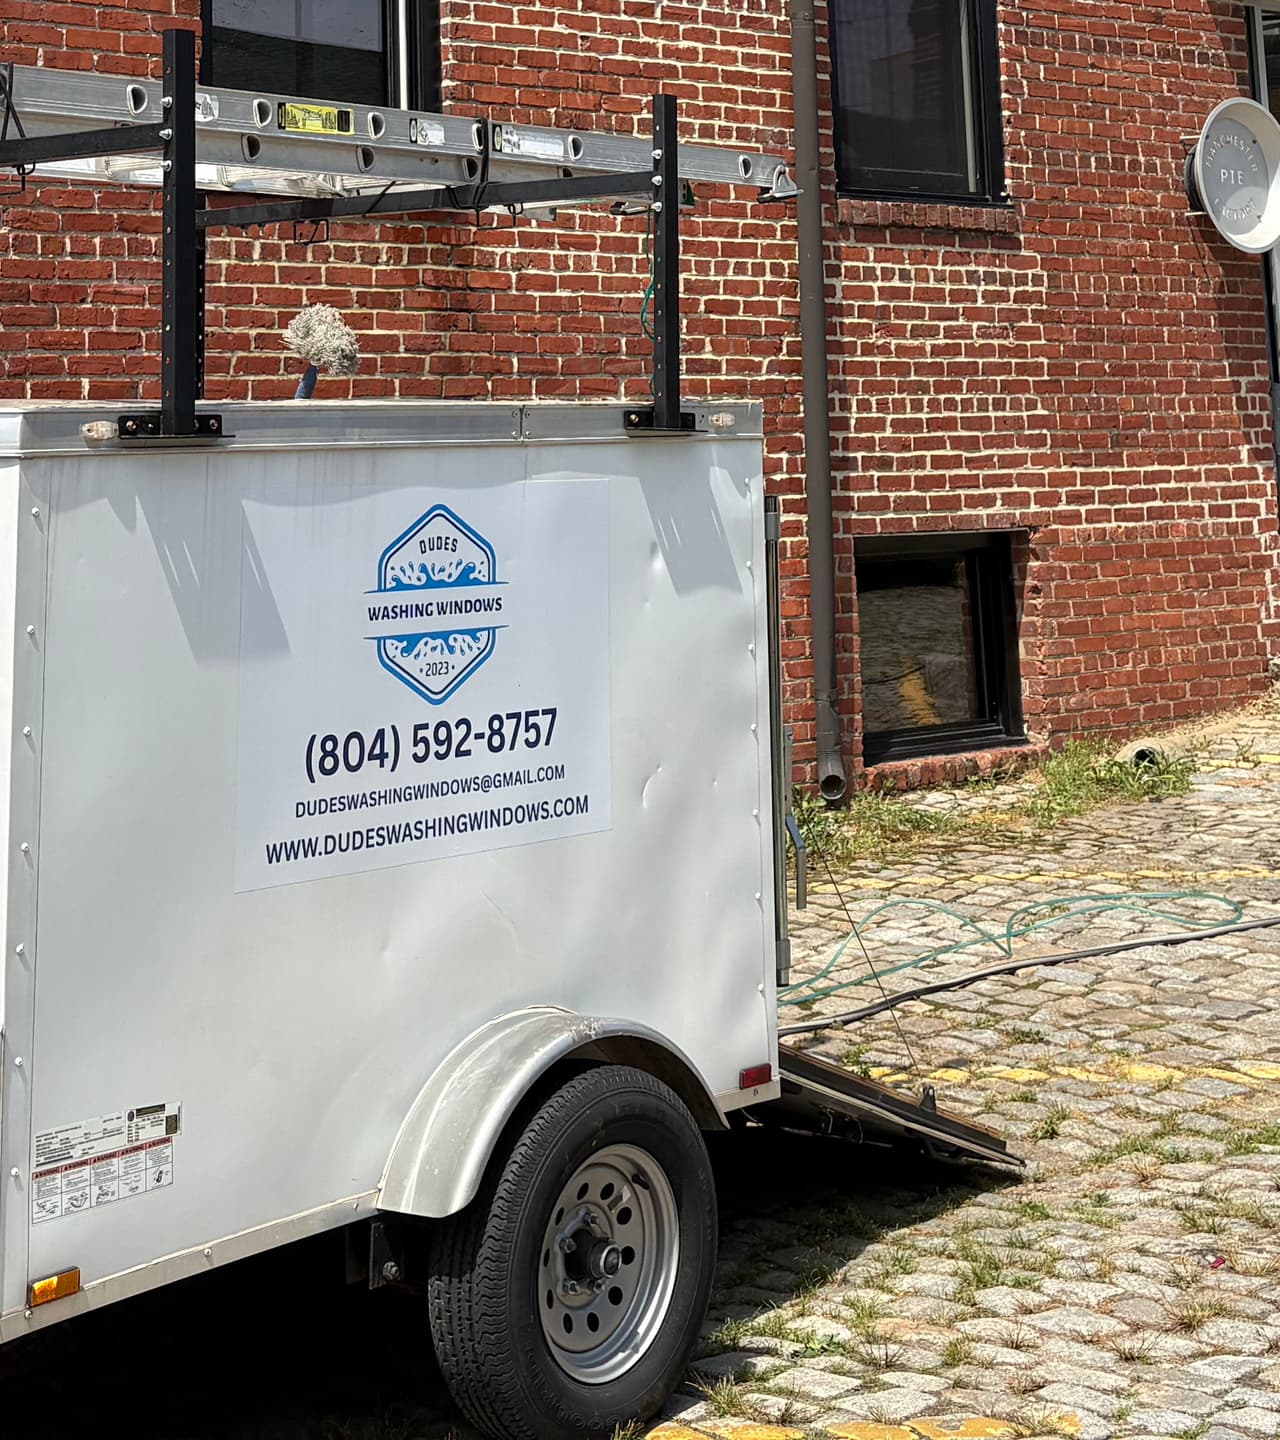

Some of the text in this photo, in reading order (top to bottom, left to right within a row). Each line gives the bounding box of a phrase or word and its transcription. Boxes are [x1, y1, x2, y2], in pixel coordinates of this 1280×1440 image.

[1221, 169, 1244, 185] PIE
[419, 535, 459, 555] DUDES
[368, 597, 503, 622] WASHING WINDOWS
[424, 660, 450, 677] 2023
[305, 707, 558, 784] (804) 592-8757
[295, 764, 566, 818] DUDESWASHINGWINDOWS@GMAIL.COM
[265, 794, 590, 865] WWW.DUDESWASHINGWINDOWS.COM
